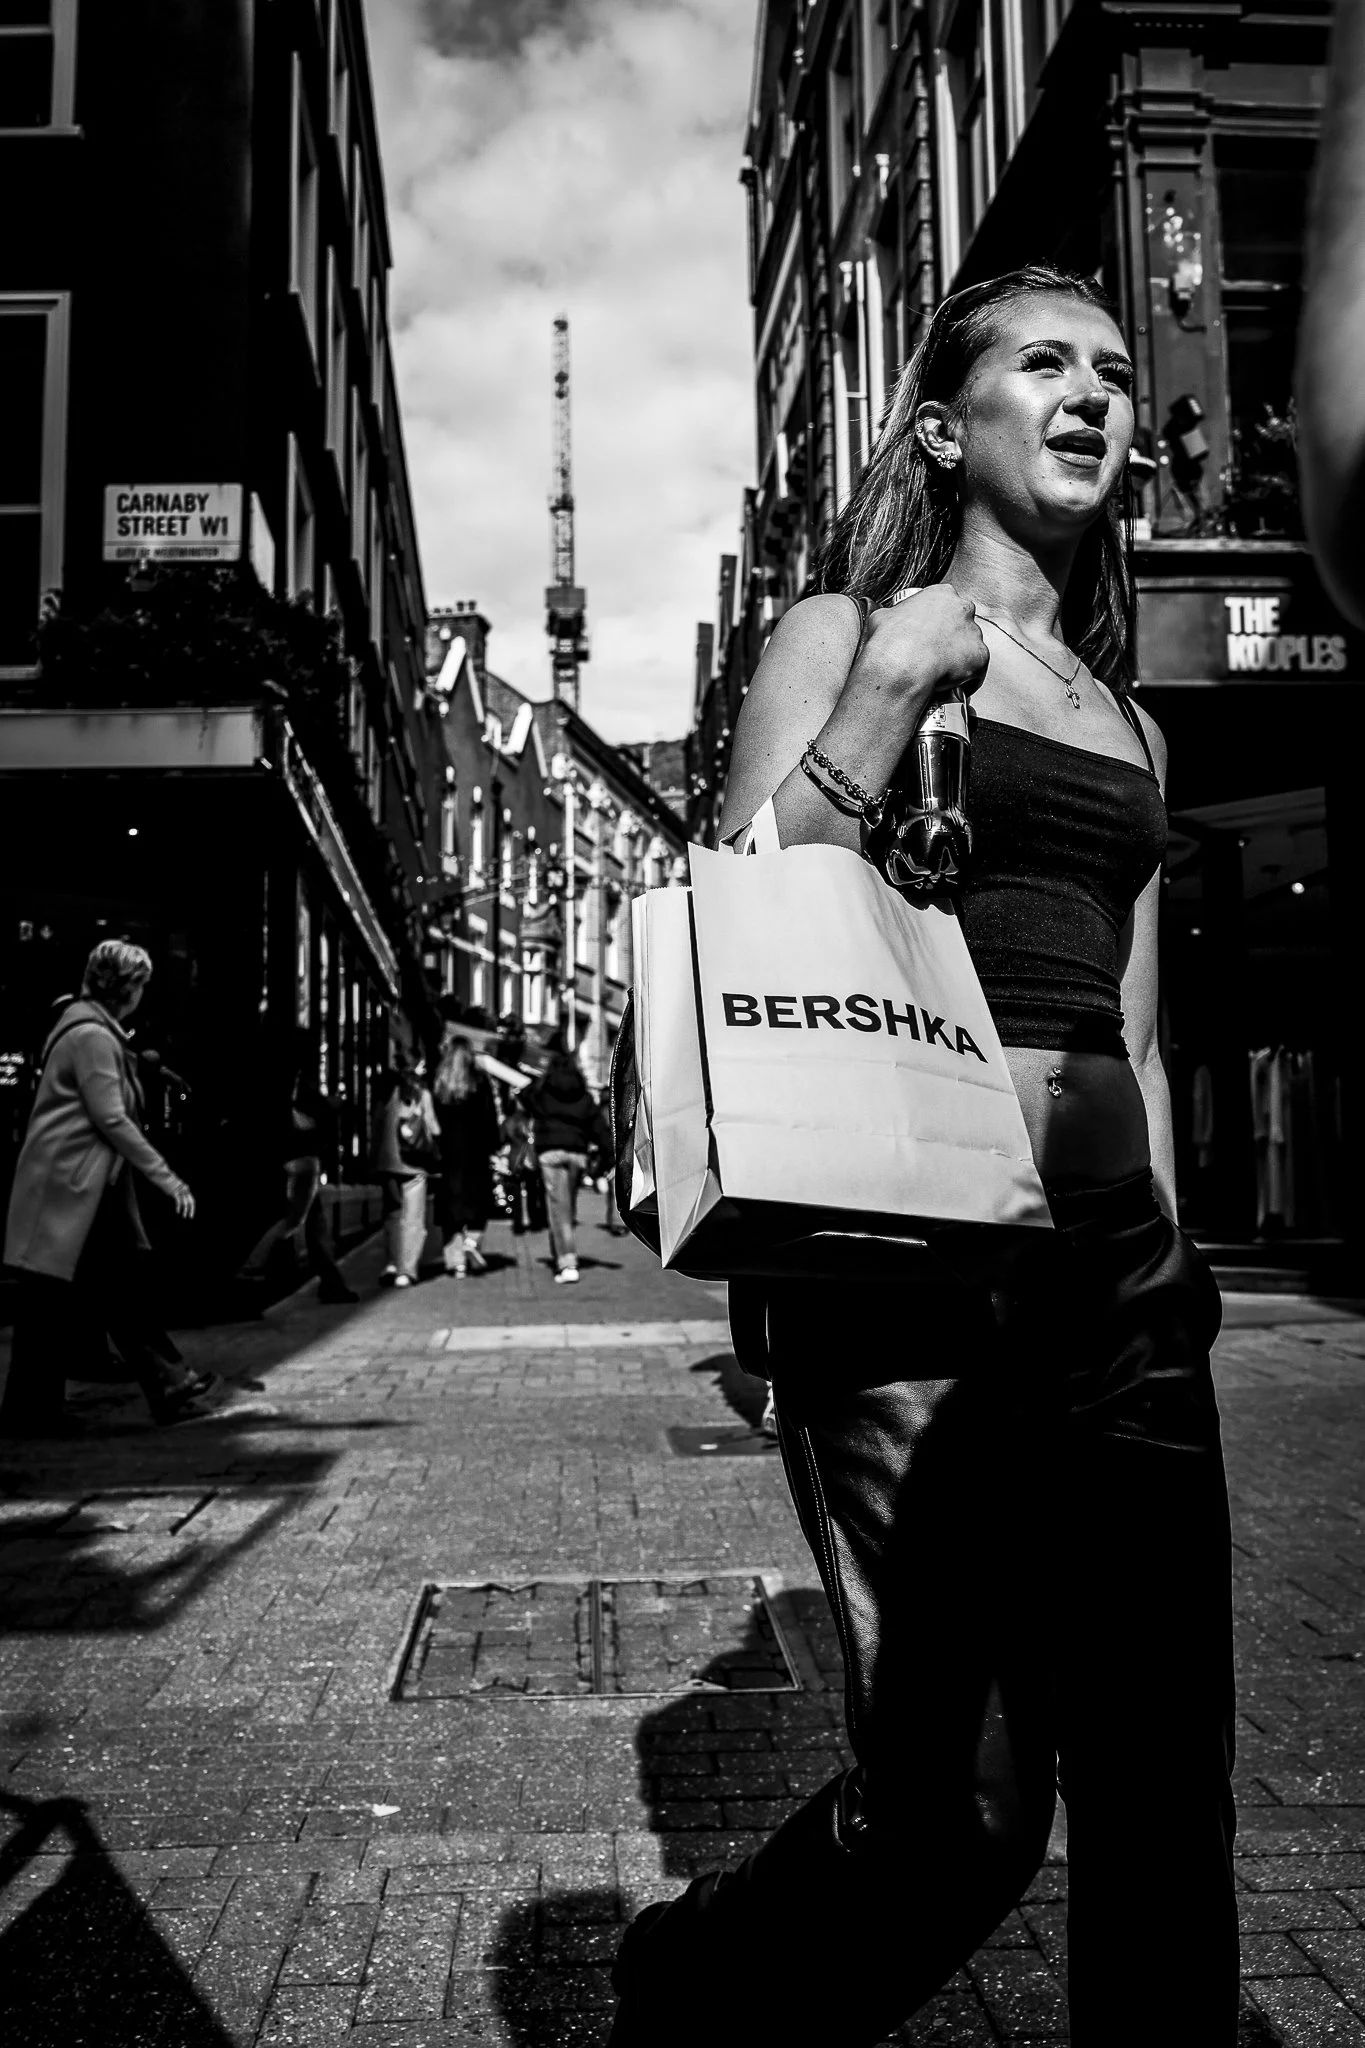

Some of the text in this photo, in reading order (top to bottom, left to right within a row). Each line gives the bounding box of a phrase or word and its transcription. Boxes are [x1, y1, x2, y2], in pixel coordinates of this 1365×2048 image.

[116, 493, 210, 513] CARNABY
[117, 515, 229, 536] STREET W1
[1224, 596, 1280, 634] THE
[722, 992, 988, 1063] BERSHKA
